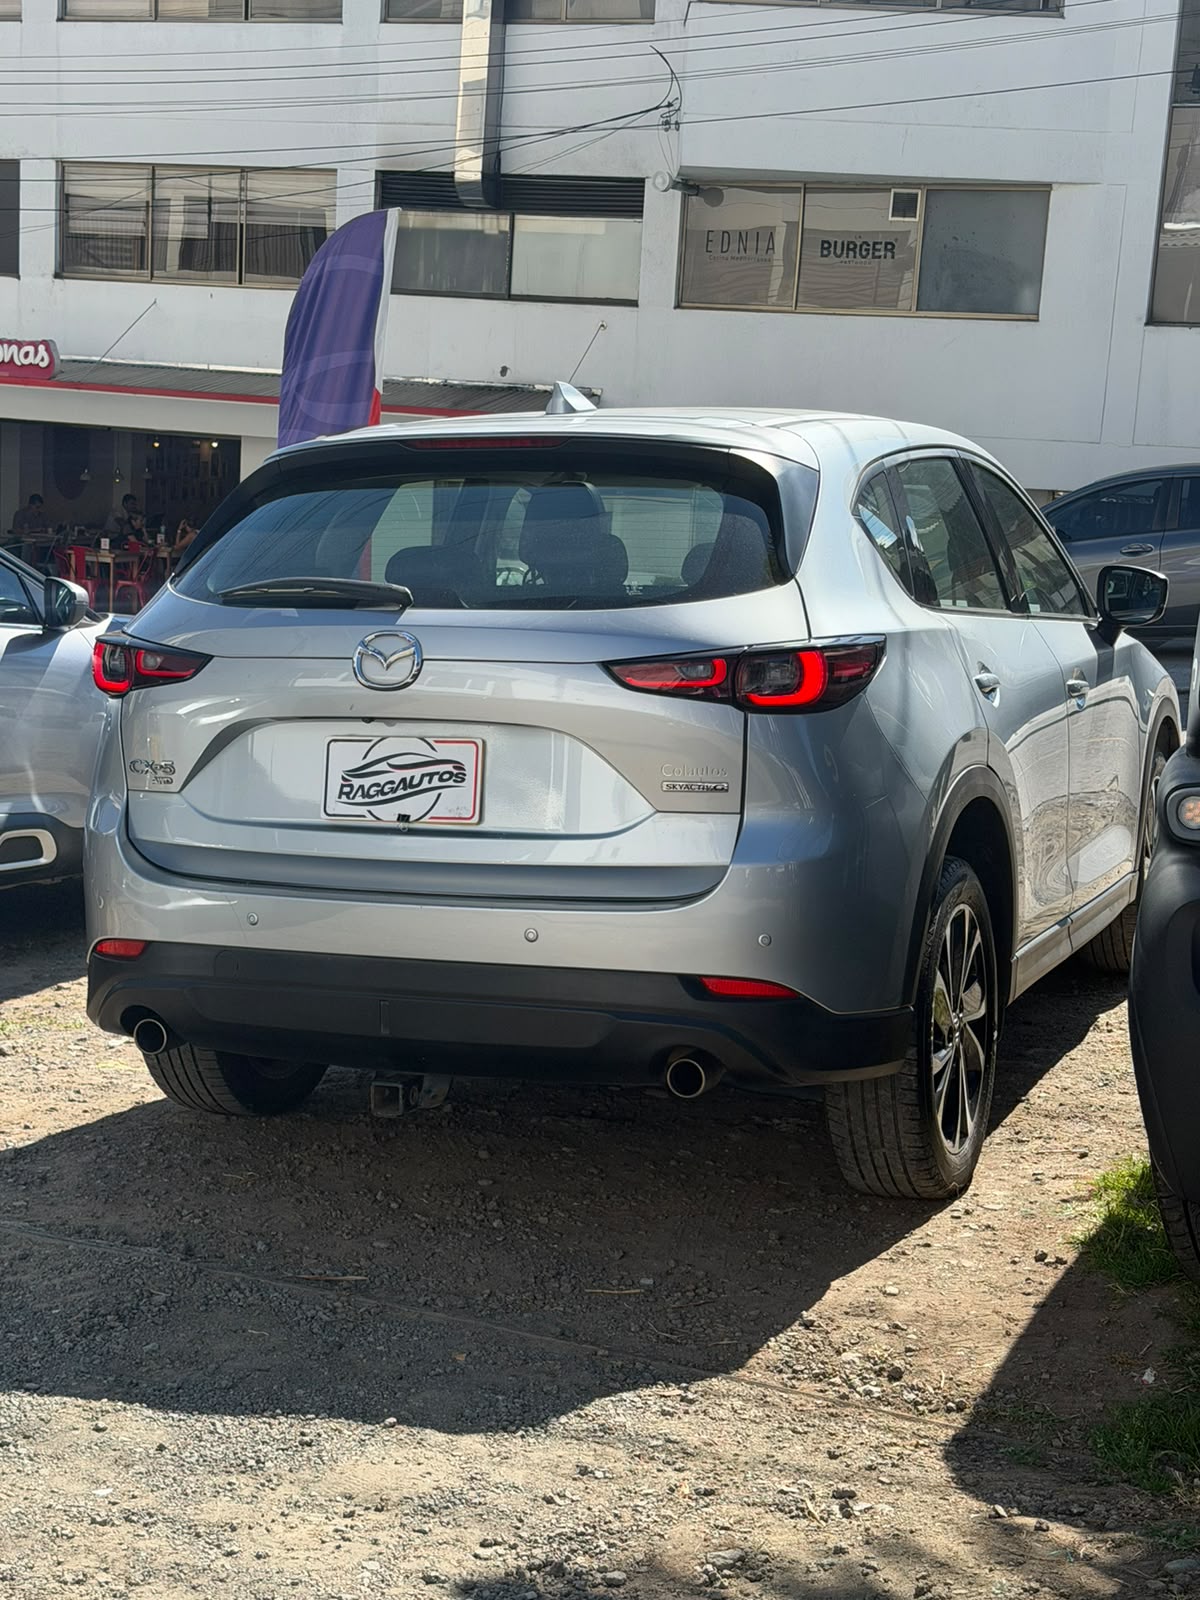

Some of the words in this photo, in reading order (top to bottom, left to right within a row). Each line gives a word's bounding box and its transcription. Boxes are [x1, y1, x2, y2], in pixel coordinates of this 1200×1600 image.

[705, 230, 776, 254] EDNIA
[820, 239, 896, 259] BURGER
[0, 343, 50, 368] nas
[129, 759, 176, 776] CX-5
[661, 763, 729, 778] Colautos
[337, 770, 467, 800] RAGGAUTOS
